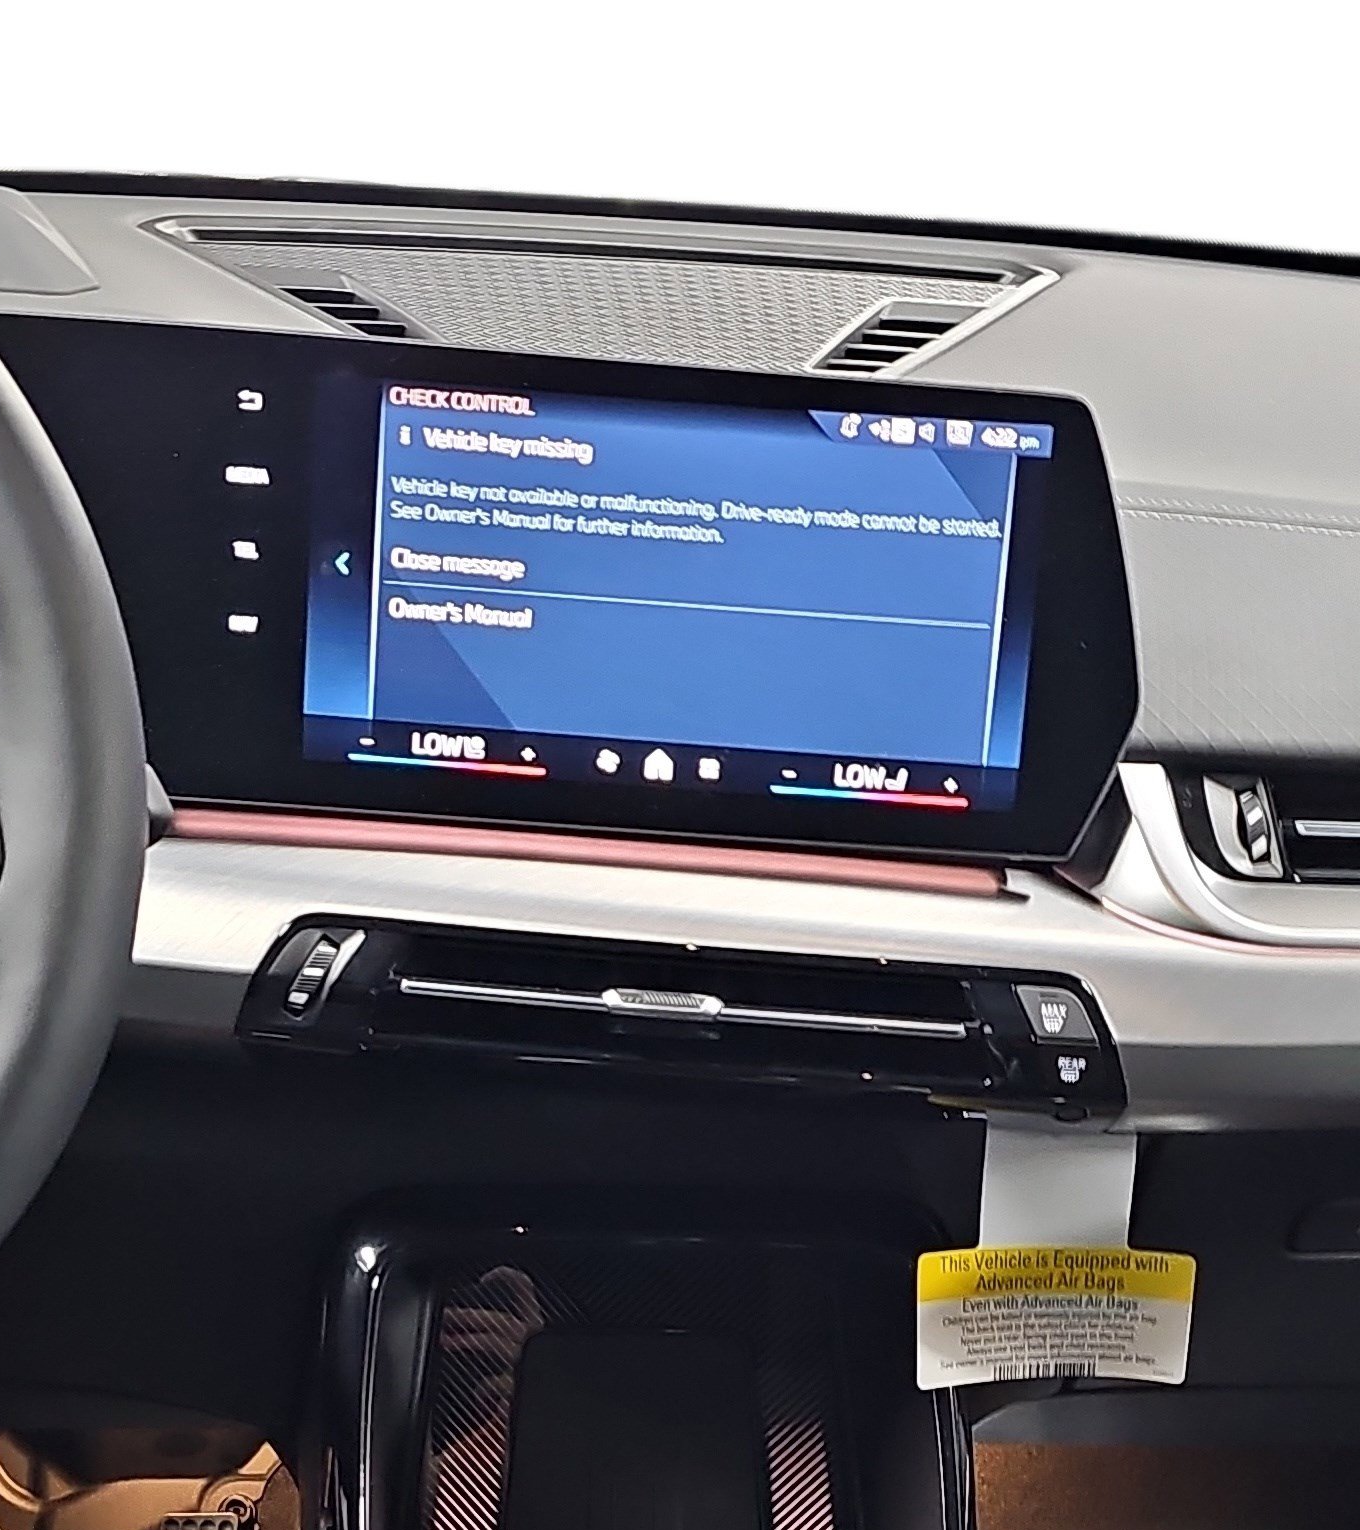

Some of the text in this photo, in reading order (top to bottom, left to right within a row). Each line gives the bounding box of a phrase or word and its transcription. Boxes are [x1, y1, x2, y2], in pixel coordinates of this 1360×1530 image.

[390, 386, 536, 416] CHECK CONTROL
[423, 426, 593, 465] Vehicle key missing
[391, 476, 448, 499] Vehicle
[449, 482, 478, 502] key
[480, 487, 507, 502] not
[508, 487, 578, 508] available
[580, 495, 598, 508] or
[600, 493, 719, 521] malfunctioning.
[721, 501, 812, 527] Drive-ready
[814, 509, 860, 529] mode
[862, 514, 917, 534] cannot
[919, 516, 940, 534] be
[391, 501, 725, 543] See Owner's Manual for further information.
[391, 546, 526, 581] Close message
[388, 597, 533, 628] Owner's Manual
[411, 731, 464, 757] LOW
[833, 763, 886, 790] LOW
[1058, 1055, 1087, 1070] REAR
[940, 1249, 1169, 1274] This Vehicle is Equipped with
[975, 1270, 1125, 1294] Advanced Air Bags
[962, 1296, 991, 1313] Even
[992, 1294, 1019, 1310] with
[1020, 1294, 1082, 1309] Advanced
[1084, 1294, 1102, 1309] Air
